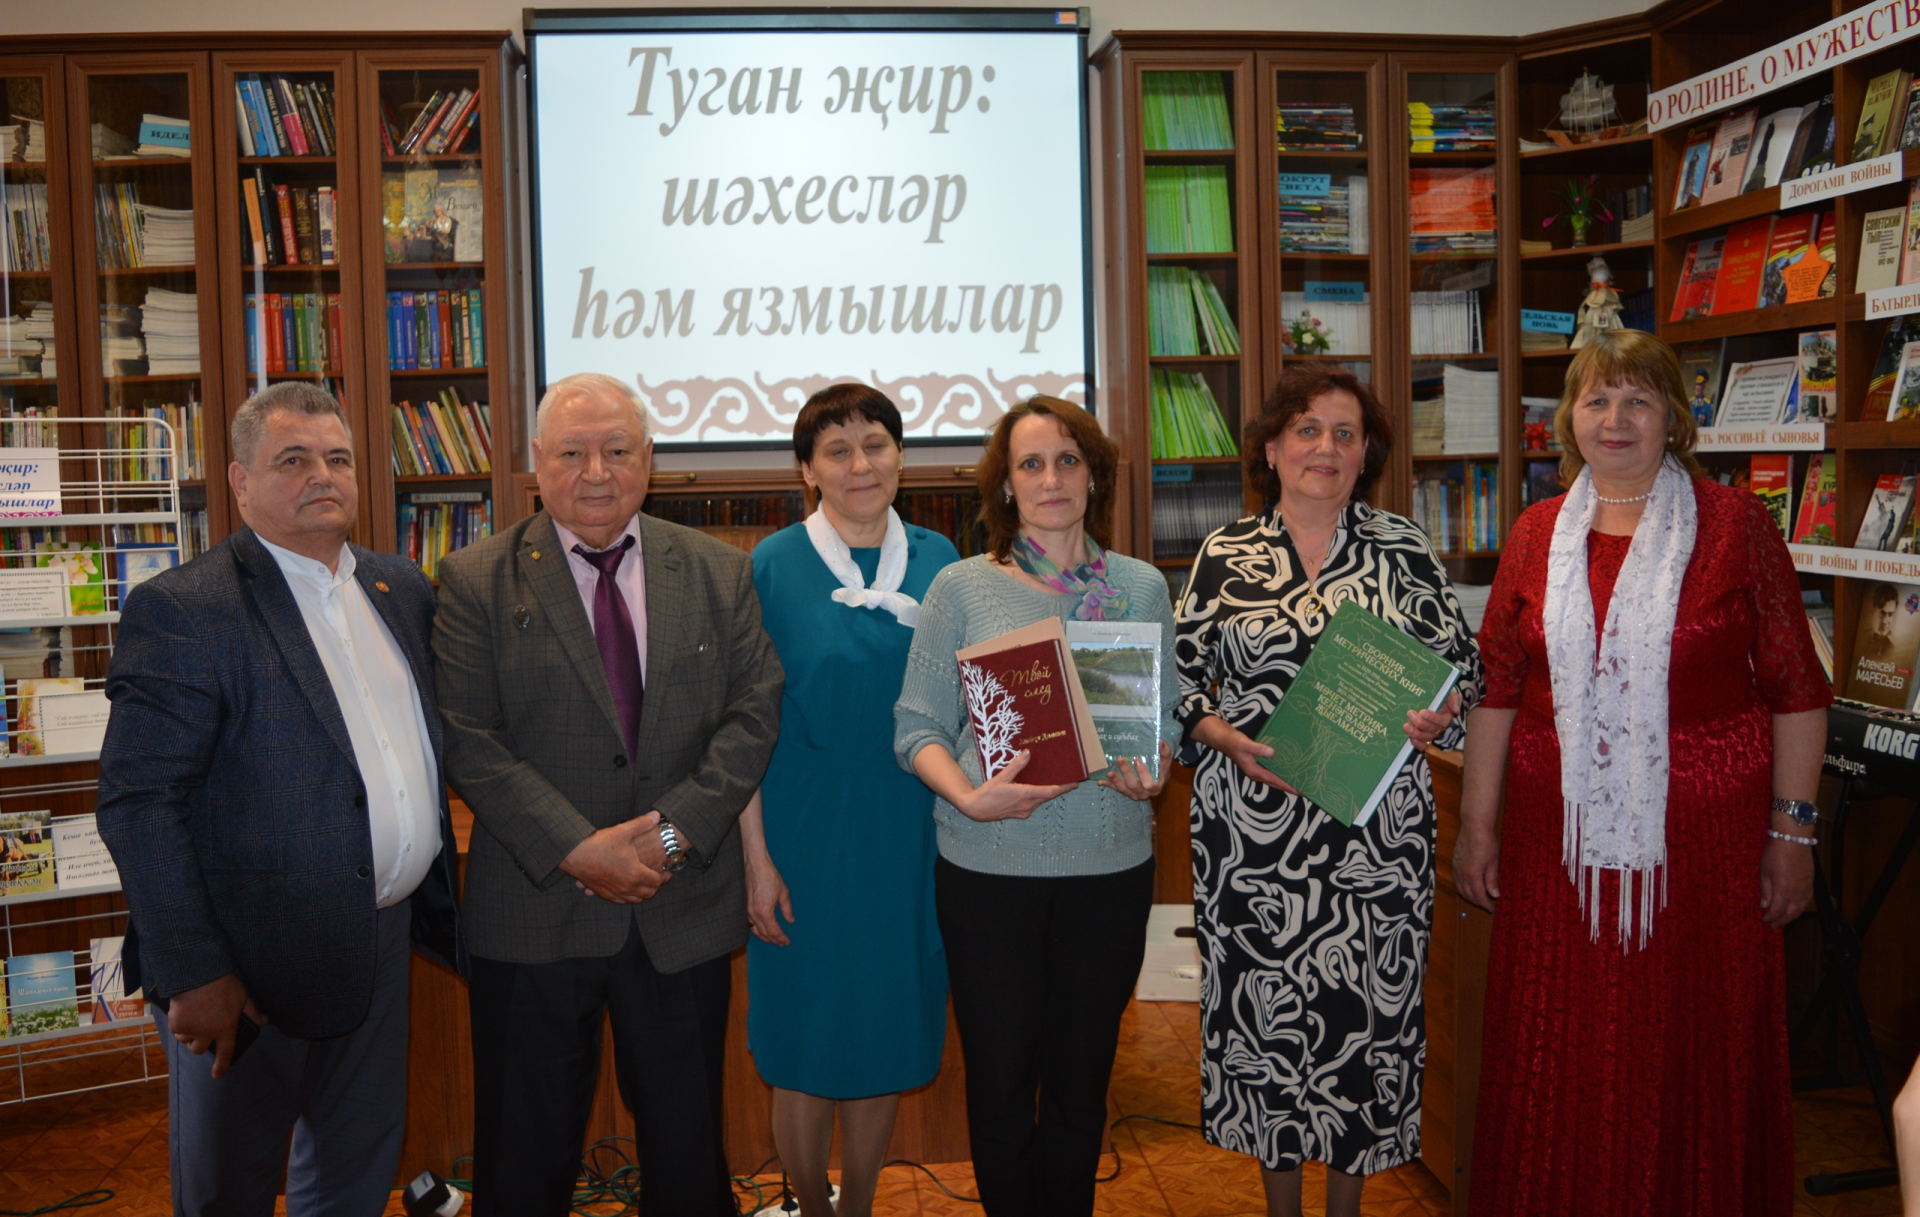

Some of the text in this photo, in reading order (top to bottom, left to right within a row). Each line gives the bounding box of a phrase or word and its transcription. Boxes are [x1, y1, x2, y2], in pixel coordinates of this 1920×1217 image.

[627, 47, 996, 137] Туган җир:
[1649, 99, 1662, 125] О
[1668, 66, 1755, 119] РОДИНЕ,
[1761, 55, 1777, 85] О
[1790, 162, 1892, 199] ДОРОГАМИ ВОЙНЫ
[661, 174, 968, 243] шәхесләр
[1314, 287, 1355, 295] СМЕНА
[1872, 294, 1920, 313] БАТЫРЛ
[571, 266, 1063, 354] һәм язмышлар
[1532, 321, 1558, 329] НОВЬ
[1718, 430, 1767, 444] РОССИИ-ЕЁ
[1772, 431, 1819, 443] СЫНОВЬЯ
[1820, 553, 1858, 571] ВОЙНЫ
[1864, 559, 1872, 571] И
[999, 660, 1052, 687] Твой
[1333, 634, 1401, 681] МЕТРИЧЕСКИХ
[1398, 676, 1426, 698] КНИГ
[1361, 642, 1406, 674] СБОРНИК
[1858, 656, 1895, 673] Алексей
[1024, 684, 1052, 705] след
[1856, 669, 1904, 689] МАРЕСЬЕВ
[1314, 681, 1390, 735] МӘЧЕТ МЕТРИКА
[1314, 703, 1369, 743] ҖЫЕЛМАСЫ
[1316, 694, 1377, 737] КЕНӘГӘЛӘРЕ
[1863, 722, 1920, 760] KORG
